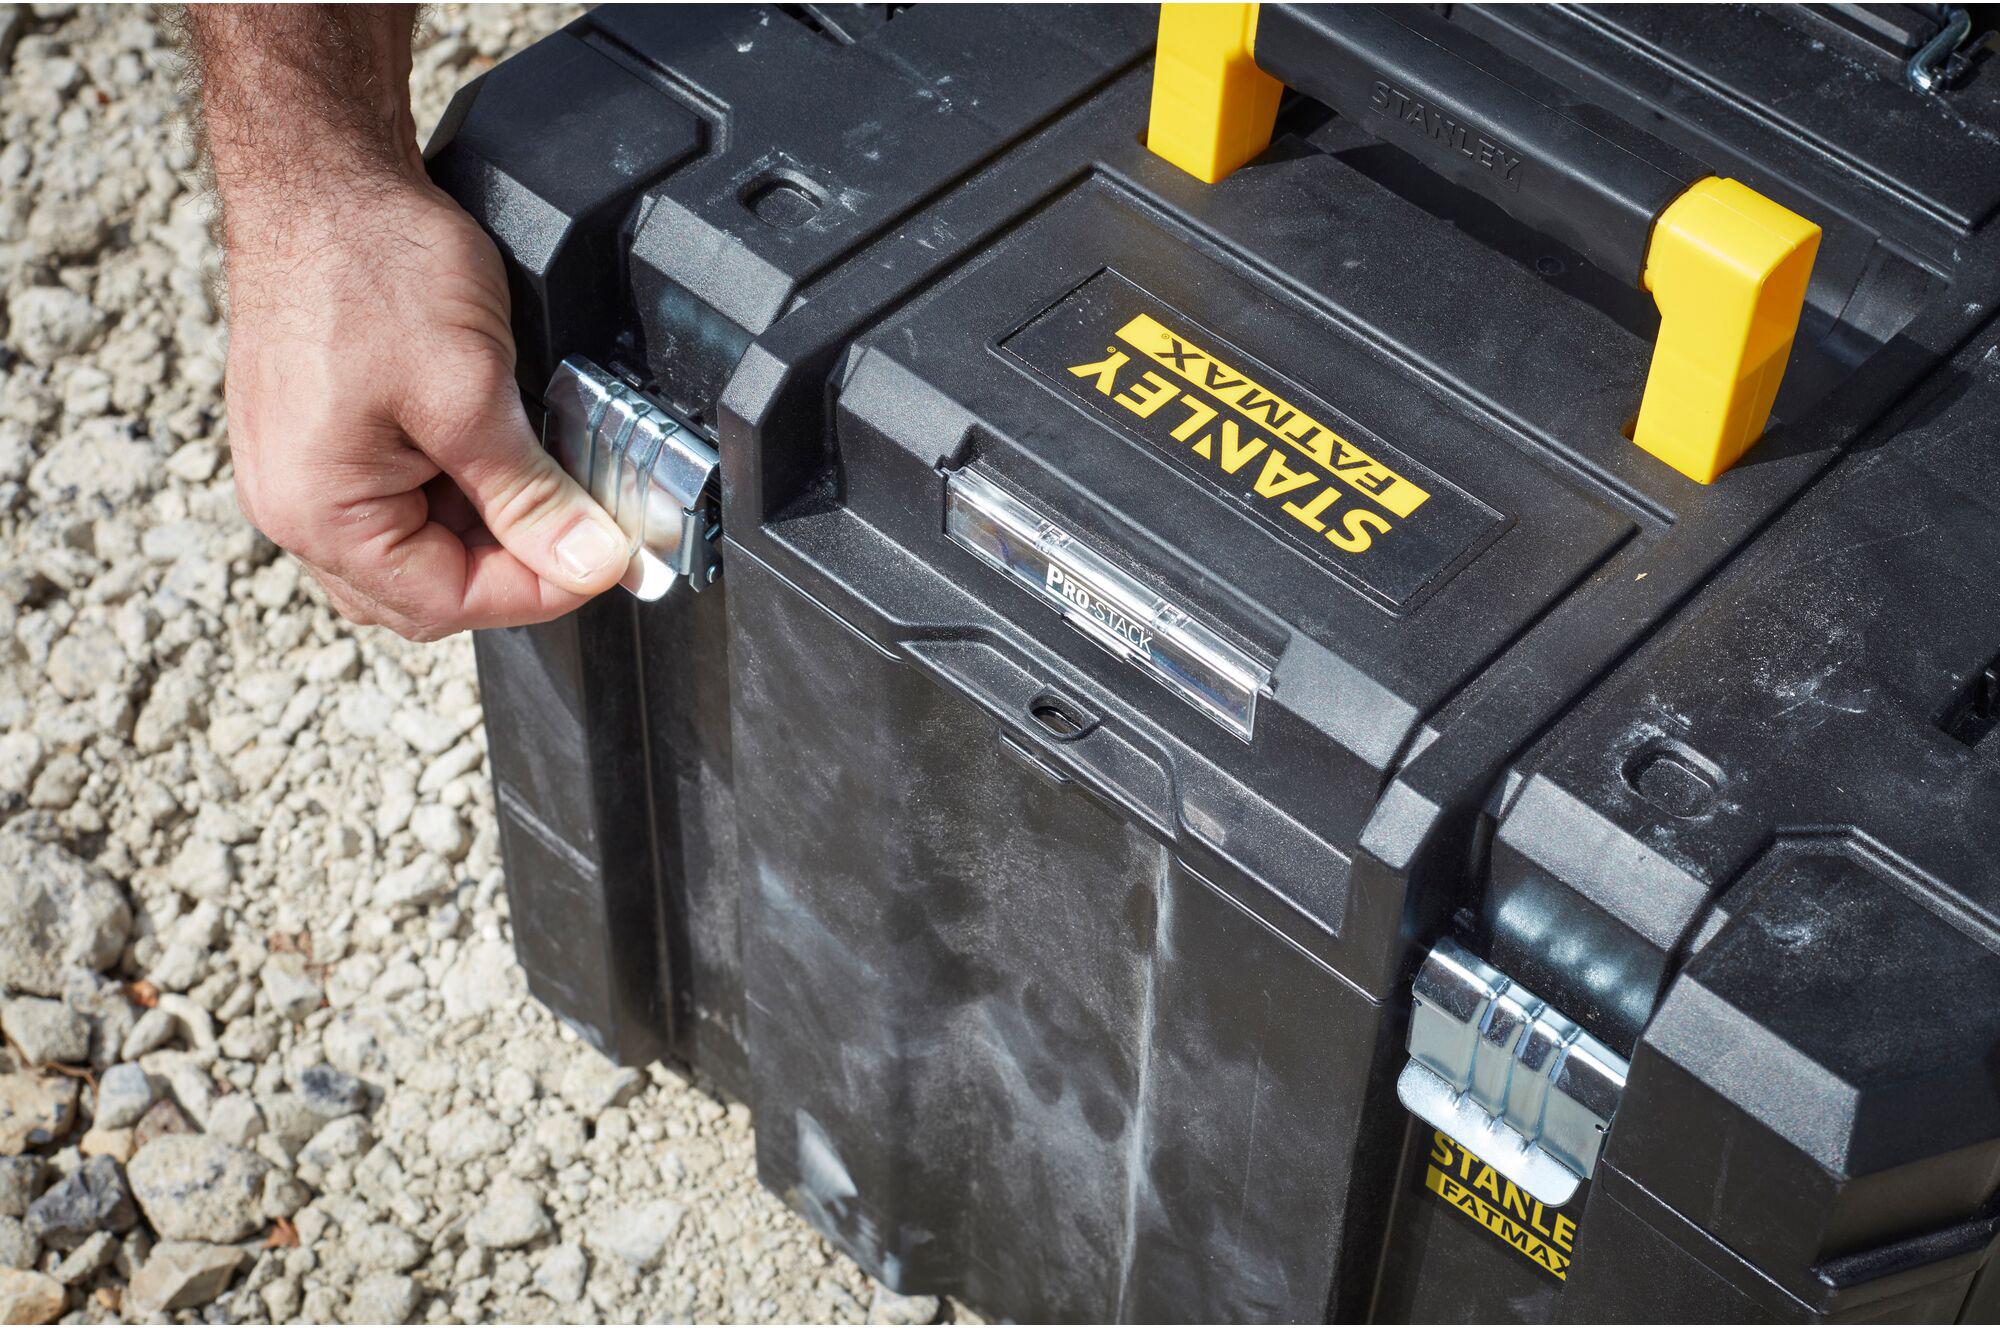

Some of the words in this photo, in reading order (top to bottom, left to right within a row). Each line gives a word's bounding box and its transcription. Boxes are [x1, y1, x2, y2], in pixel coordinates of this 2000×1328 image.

[1371, 81, 1521, 180] STANLEY
[1067, 350, 1391, 553] STANLEY
[1155, 338, 1396, 496] FATMAX
[1045, 562, 1153, 656] PRO-STACK
[1430, 1131, 1577, 1254] STANLE
